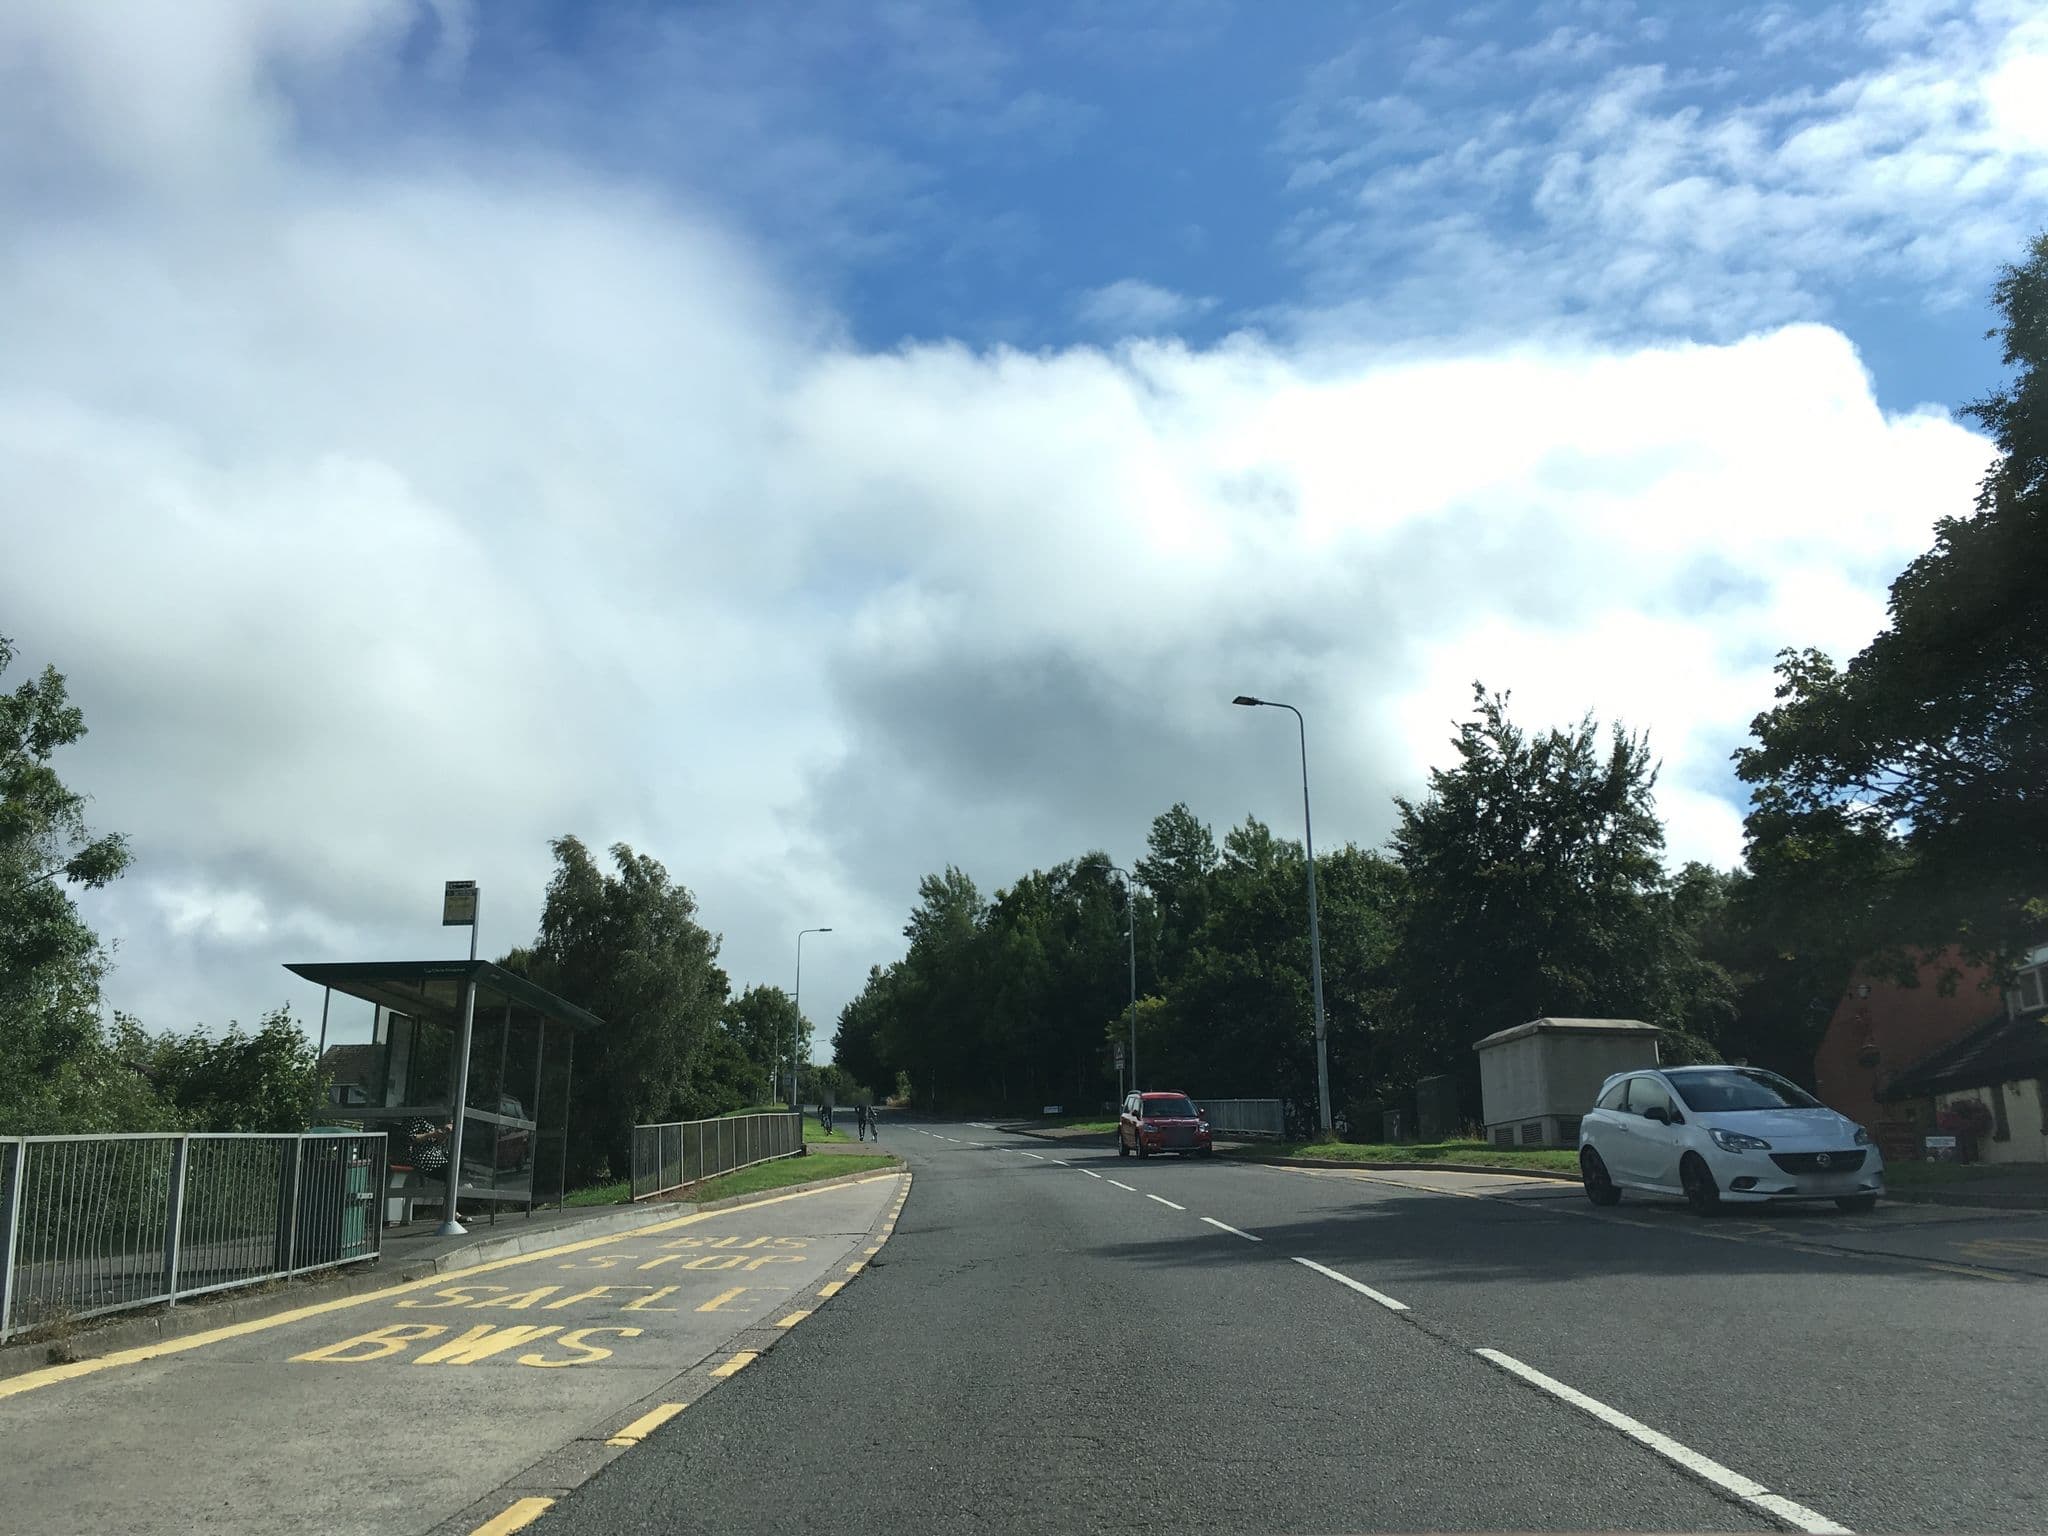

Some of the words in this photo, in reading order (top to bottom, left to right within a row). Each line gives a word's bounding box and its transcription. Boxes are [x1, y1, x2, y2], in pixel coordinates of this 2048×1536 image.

[656, 1236, 817, 1249] BUS
[558, 1254, 808, 1270] STOP
[394, 1285, 790, 1312] SAFLE
[285, 1324, 645, 1368] BWS
